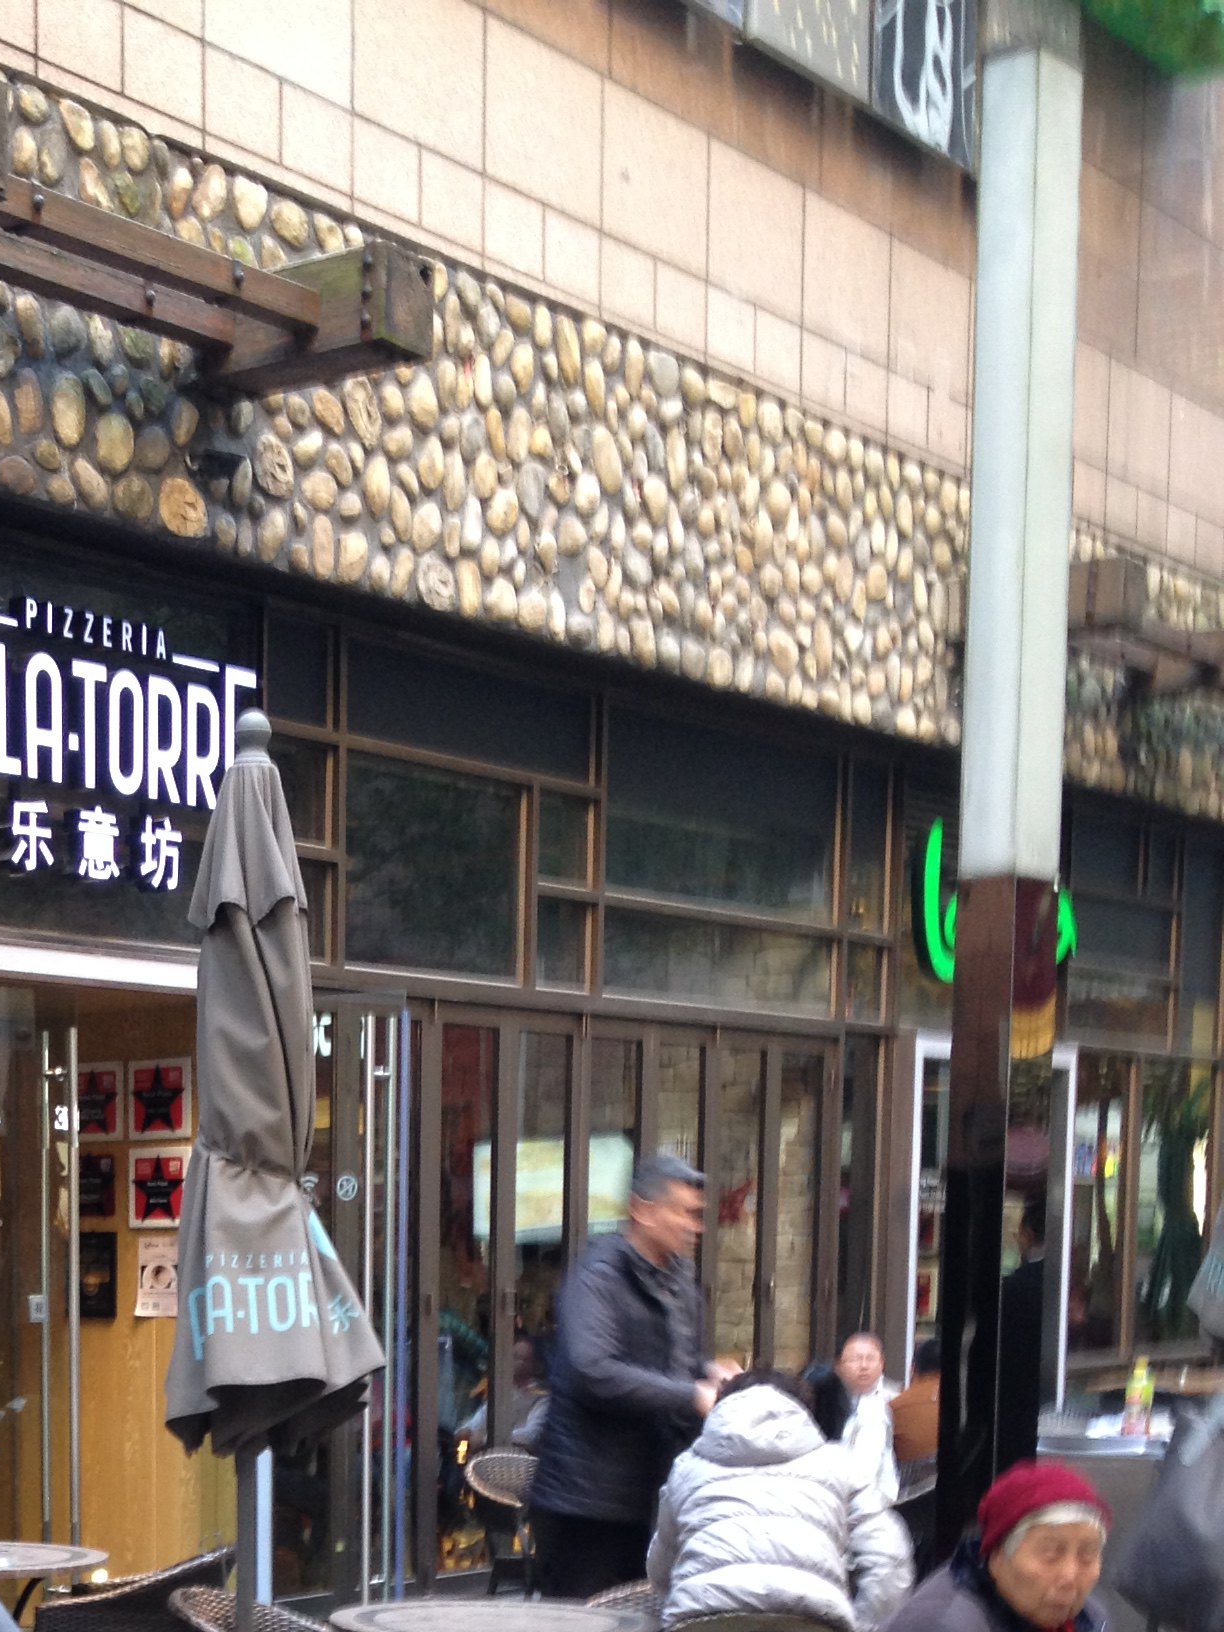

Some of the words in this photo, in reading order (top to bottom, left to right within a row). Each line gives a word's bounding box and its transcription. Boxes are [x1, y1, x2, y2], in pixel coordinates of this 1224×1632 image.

[25, 597, 168, 660] PIZZERIA
[10, 800, 184, 891] 乐意坊
[205, 1250, 310, 1269] PIZZERIA
